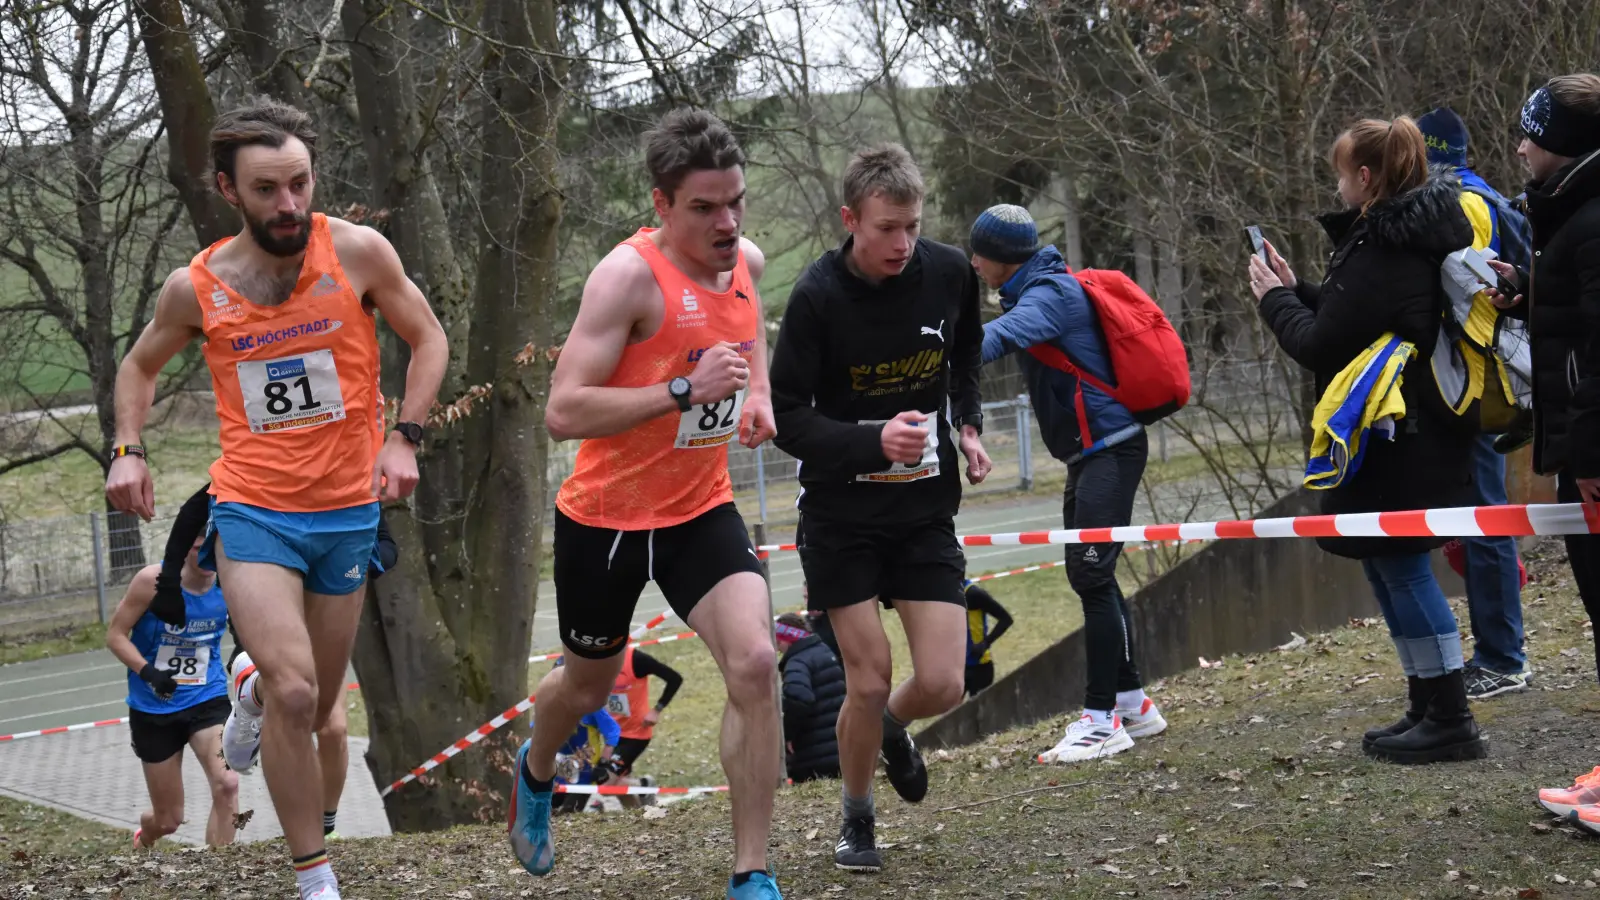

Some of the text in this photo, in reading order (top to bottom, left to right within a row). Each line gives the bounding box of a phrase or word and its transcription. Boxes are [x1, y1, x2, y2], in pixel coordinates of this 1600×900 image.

[676, 312, 707, 321] Sparkasse
[230, 318, 330, 351] LSC HÖCHSTADT
[687, 347, 710, 362] LS
[263, 376, 321, 415] 81
[262, 404, 341, 422] BAYERISCHE MEISTERSCHAFTEN
[698, 392, 736, 431] 82
[283, 414, 328, 428] Indersdorf
[570, 628, 608, 646] LSC
[168, 657, 198, 675] 98
